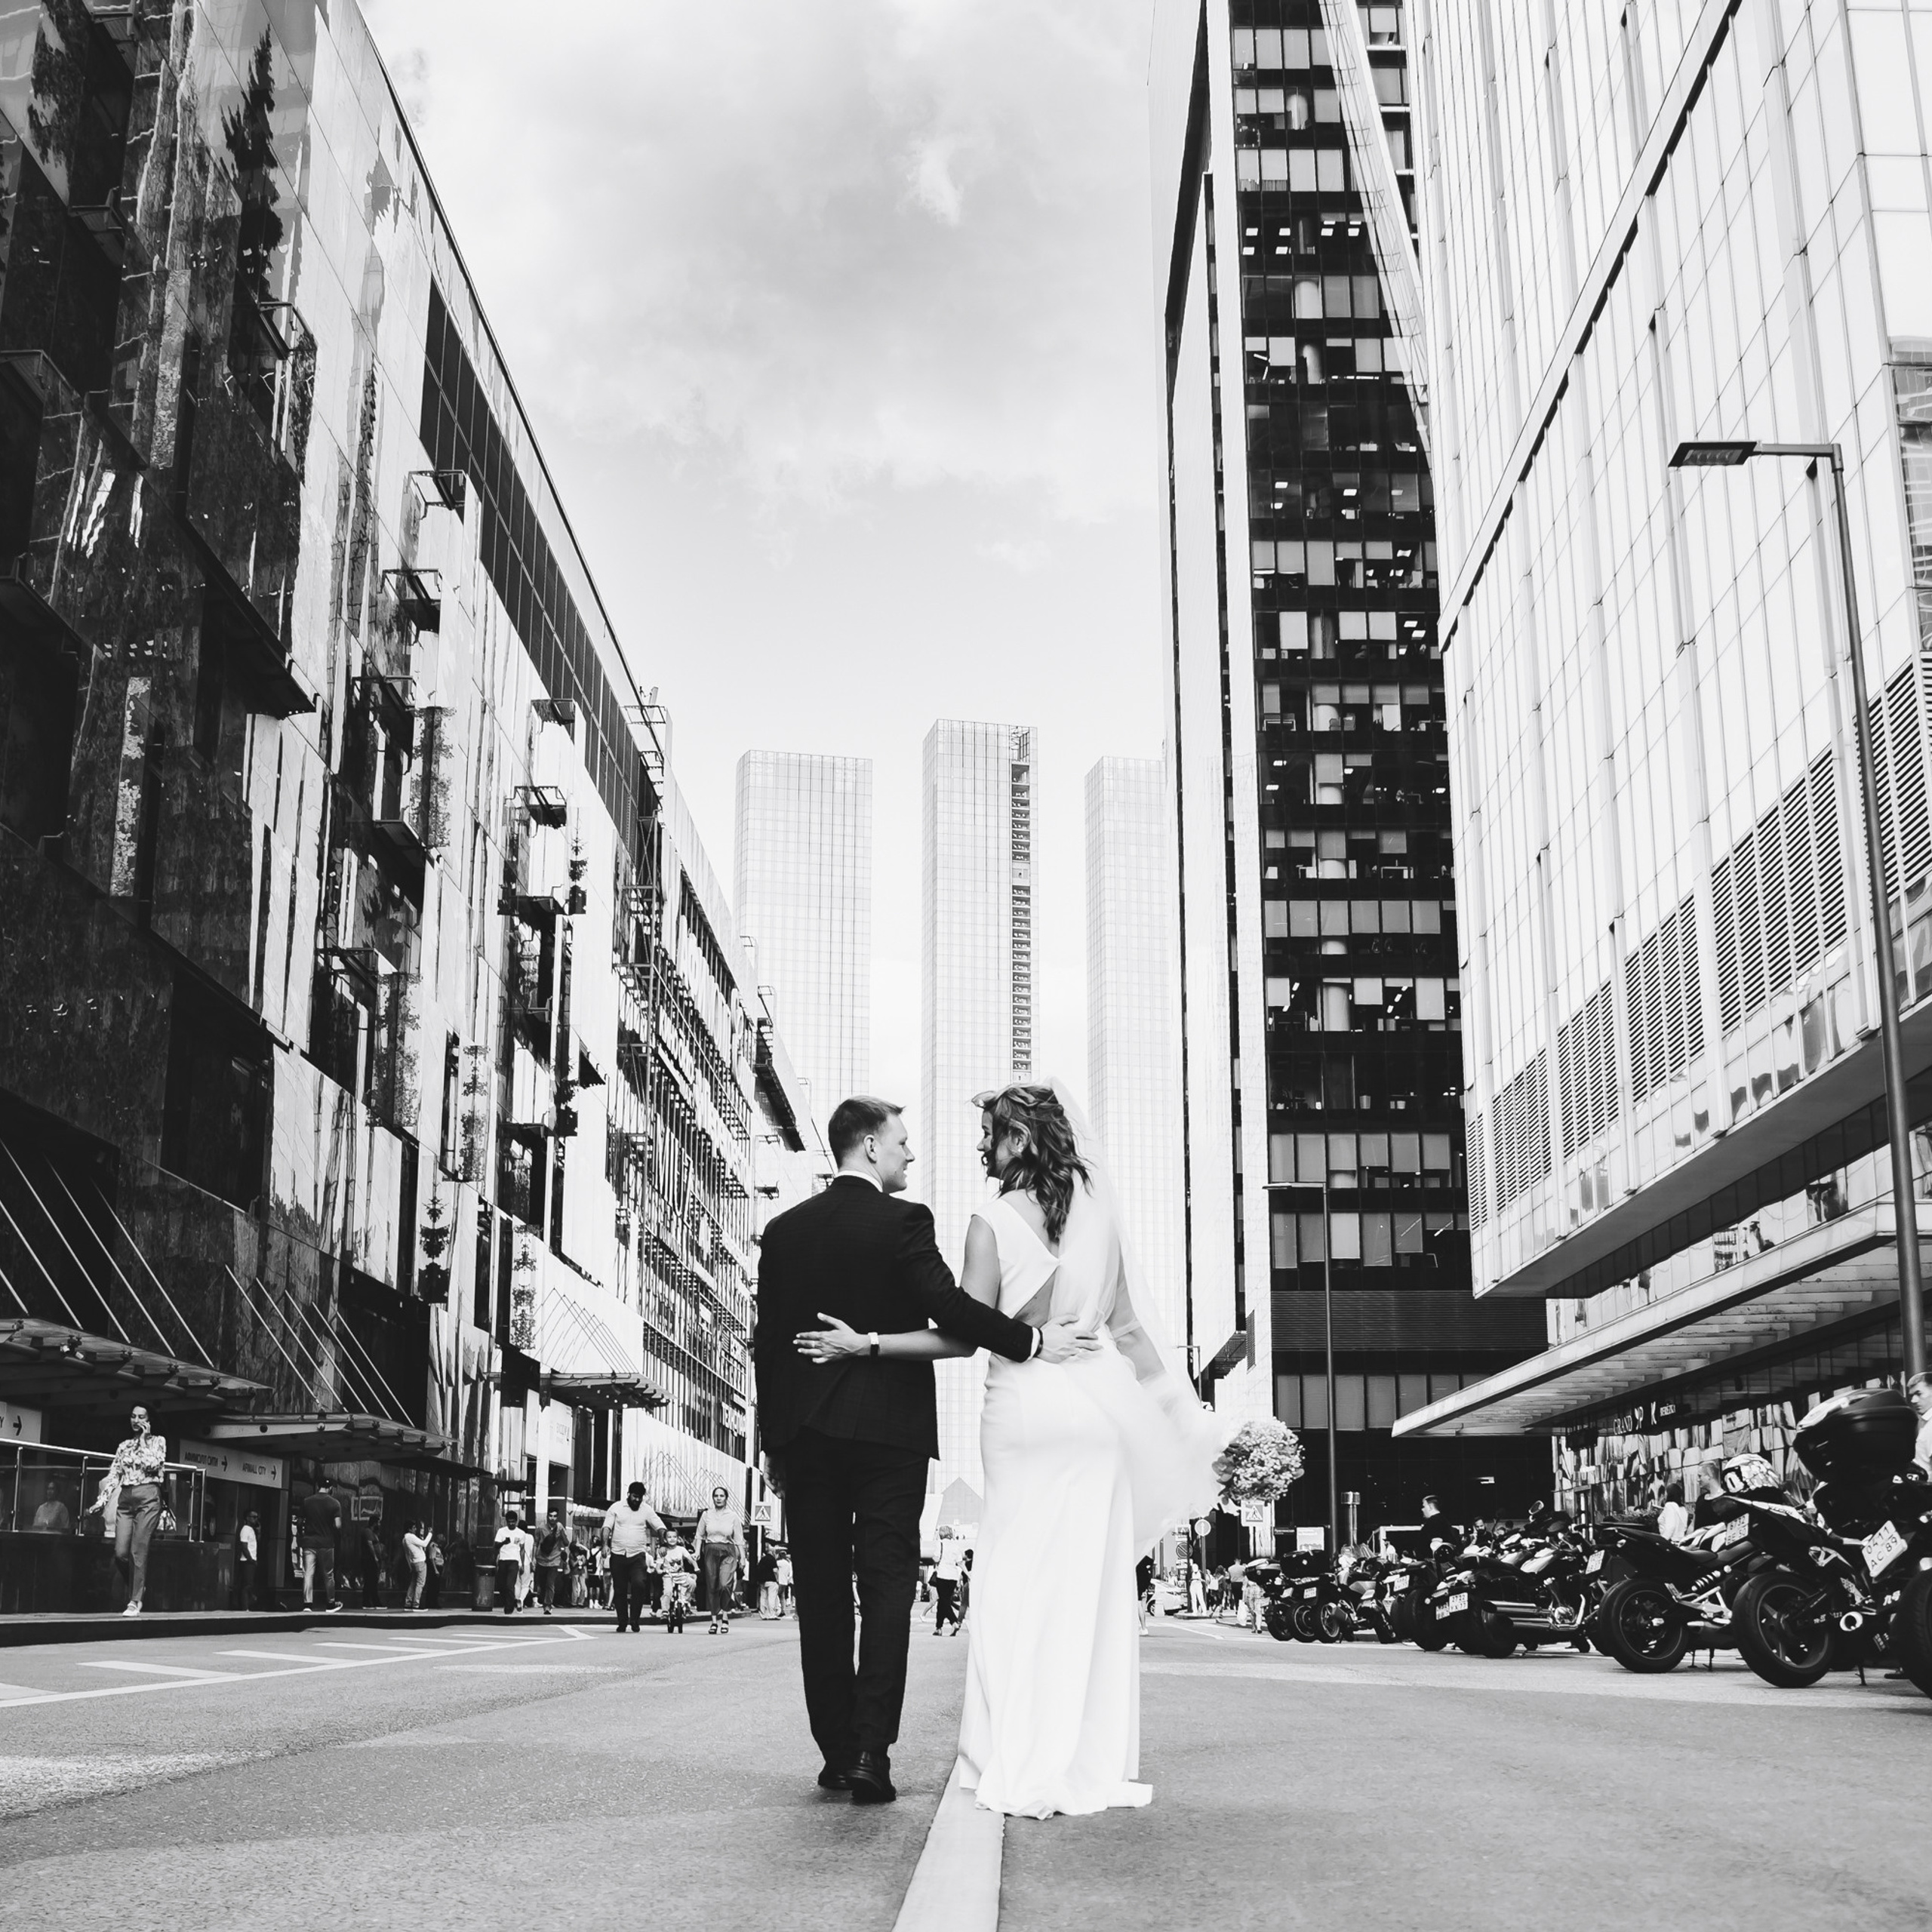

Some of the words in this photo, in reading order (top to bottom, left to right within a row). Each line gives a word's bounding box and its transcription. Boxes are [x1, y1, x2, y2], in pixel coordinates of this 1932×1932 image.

[1613, 1415, 1632, 1435] GRAND
[1866, 1526, 1890, 1554] 0411
[1885, 1537, 1897, 1552] 89
